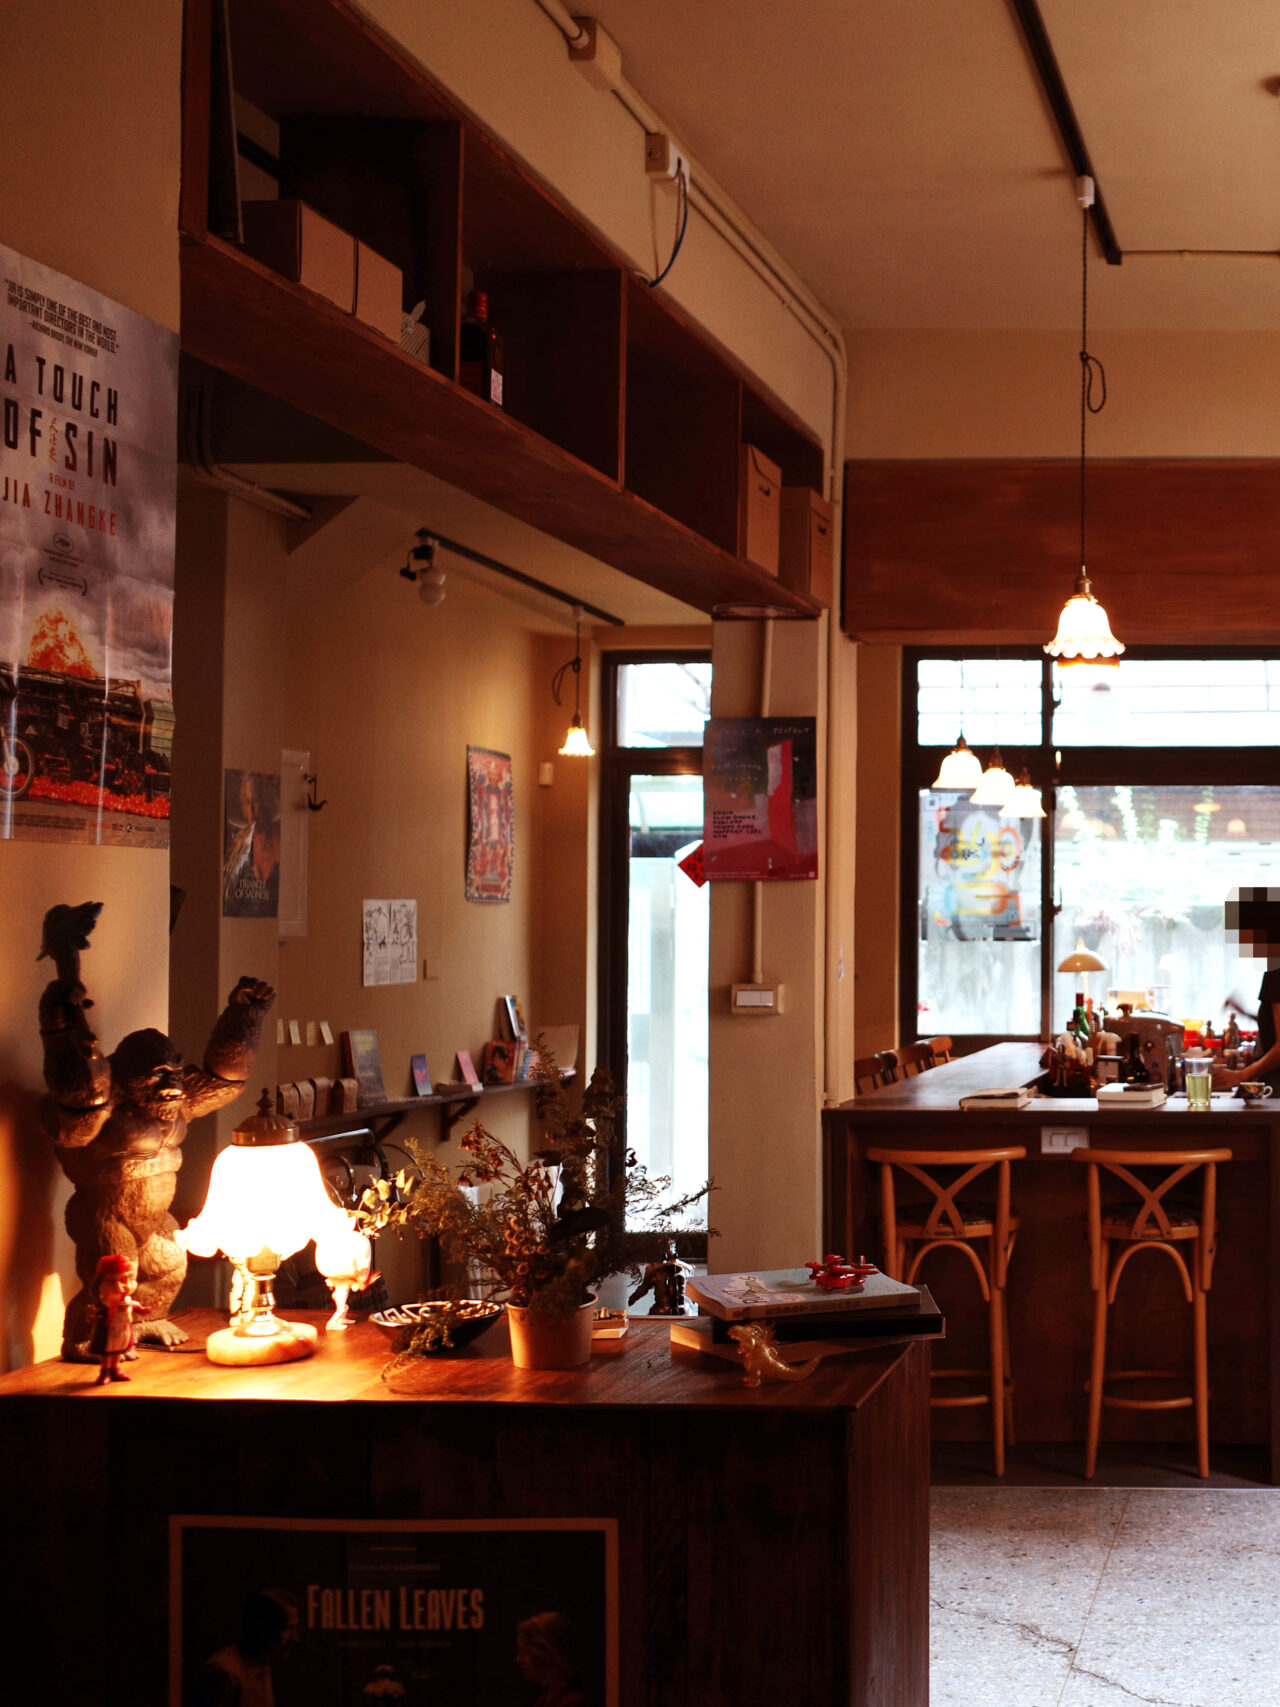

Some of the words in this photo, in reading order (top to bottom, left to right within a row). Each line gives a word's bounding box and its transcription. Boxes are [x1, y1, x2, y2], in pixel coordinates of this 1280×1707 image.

[7, 292, 42, 320] IMPORTANT
[44, 310, 77, 336] DIRECTORS
[77, 324, 84, 339] IN
[84, 328, 95, 345] THE
[24, 288, 45, 309] SIMPLY
[46, 298, 58, 314] ONE
[58, 303, 66, 317] OF
[67, 308, 78, 324] THE
[78, 313, 92, 330] BEST
[5, 343, 17, 384] A
[36, 356, 118, 426] TOUCH
[4, 398, 42, 457] OF
[65, 422, 117, 487] SIN
[3, 476, 31, 508] JIA
[44, 490, 117, 536] ZHANGKE
[55, 475, 67, 489] FILM
[307, 1585, 391, 1630] FALLEN
[400, 1586, 485, 1630] LEAVES
